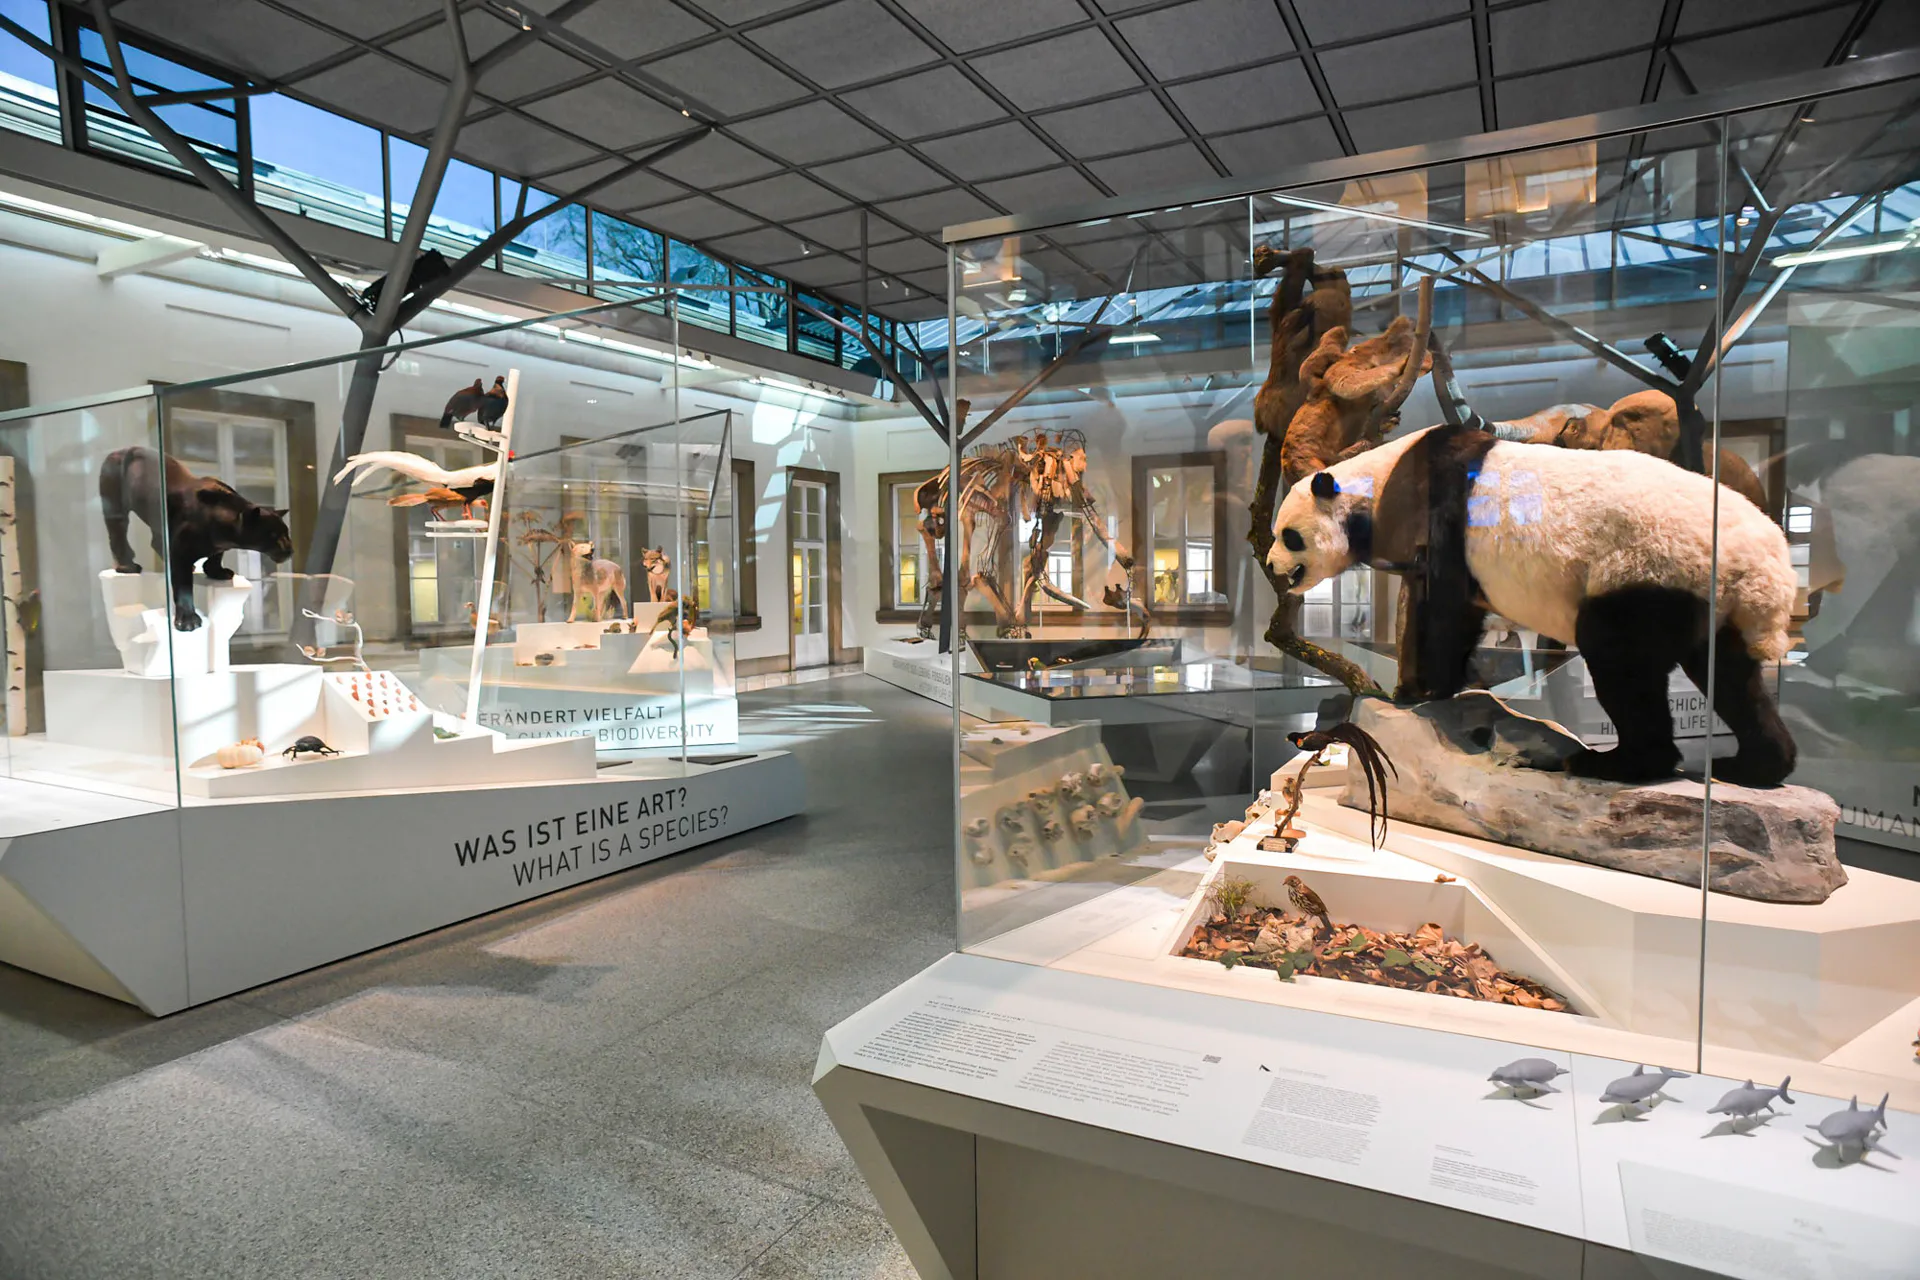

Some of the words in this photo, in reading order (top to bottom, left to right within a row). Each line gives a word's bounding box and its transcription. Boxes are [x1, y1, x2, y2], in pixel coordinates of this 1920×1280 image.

[1669, 697, 1707, 711] CHICH
[479, 709, 577, 726] ERÄNDERT
[583, 706, 665, 722] VIELFALT
[1680, 715, 1708, 729] LIFE
[598, 723, 715, 742] BIODIVERSITY
[454, 829, 517, 867] WAS
[528, 816, 566, 848] IST
[576, 801, 629, 836] EINE
[637, 787, 688, 820] ART?
[513, 845, 583, 887] WHAT
[592, 838, 611, 864] IS
[619, 833, 632, 856] A
[639, 805, 729, 850] SPECIES?
